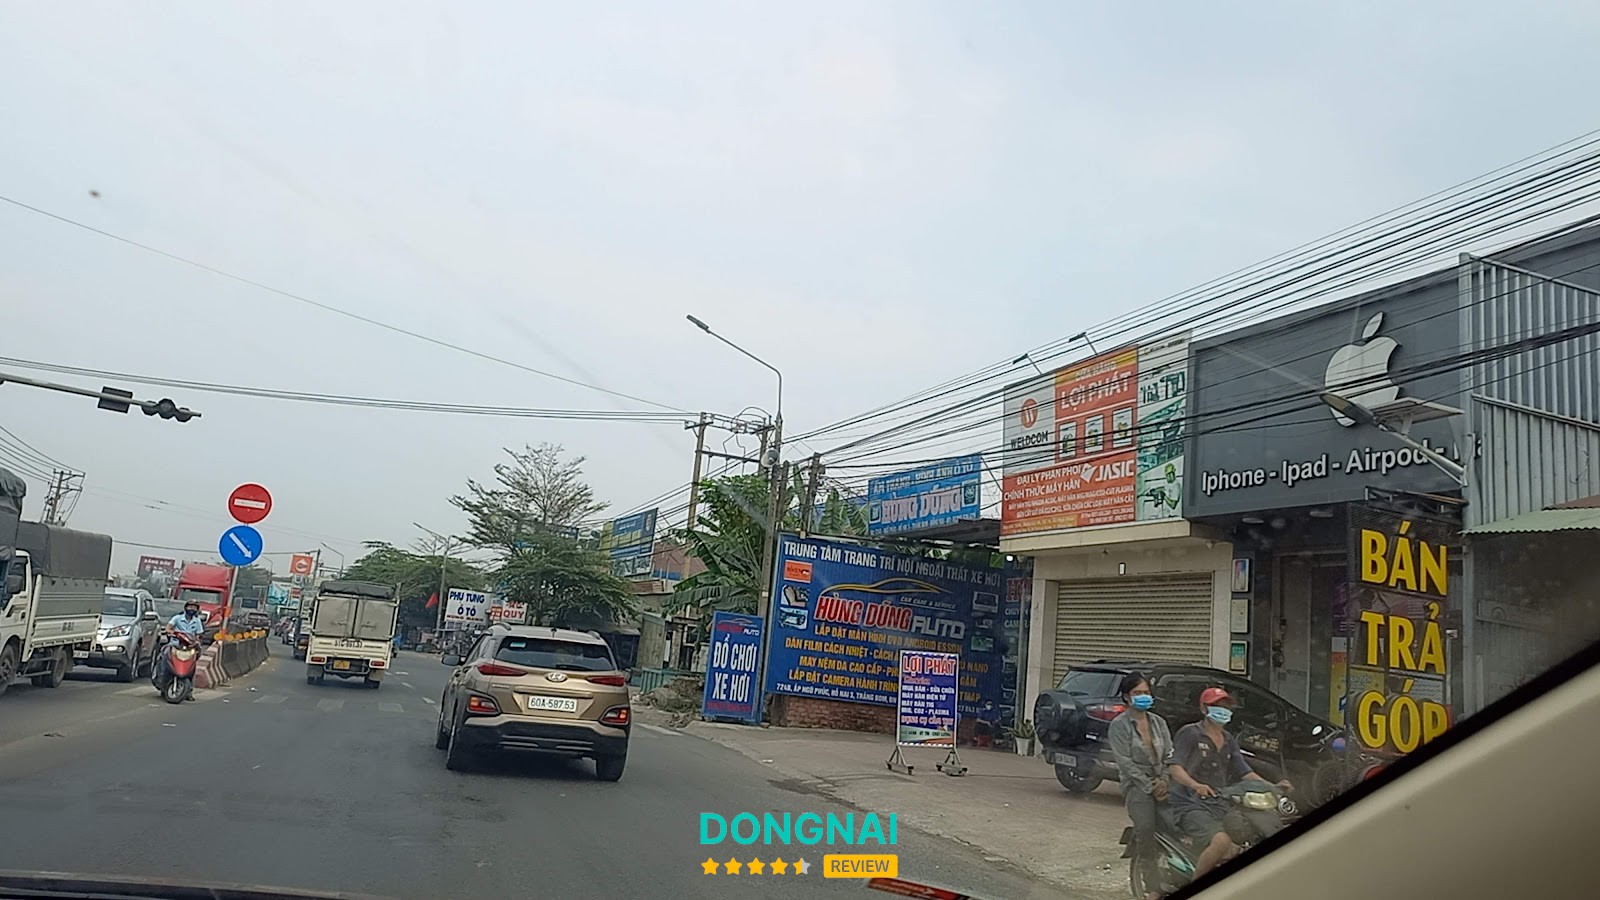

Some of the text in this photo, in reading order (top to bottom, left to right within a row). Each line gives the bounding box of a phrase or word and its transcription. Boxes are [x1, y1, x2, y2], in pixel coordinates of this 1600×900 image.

[1061, 371, 1132, 411] LỢI PHÁT
[1010, 430, 1049, 449] WELDCOM
[1095, 459, 1135, 482] JASIC
[1201, 469, 1265, 497] Iphone
[1281, 453, 1327, 487] Ipad
[1046, 480, 1063, 494] MÁY
[881, 491, 918, 525] HÙNG
[919, 483, 963, 518] DŨNG
[784, 541, 1001, 587] TRUNG TÂM TRANG TRÍ NỘI NGOẠI THẤT XE HƠI
[1360, 520, 1448, 596] BÁN
[449, 591, 464, 604] PHỤ
[503, 609, 525, 619] QUY
[813, 592, 966, 639] HÙNG DŨNG AUTO
[803, 639, 823, 650] FILM
[823, 641, 845, 655] CÁCH
[845, 644, 869, 659] NHIỆT
[873, 647, 893, 661] CÁCH
[887, 634, 902, 646] DVD
[904, 637, 937, 650] ANDROID
[1360, 601, 1447, 675] TRẢ
[730, 642, 758, 673] CHƠI
[799, 655, 817, 667] MAY
[836, 660, 848, 671] DA
[848, 662, 865, 674] CAO
[866, 660, 883, 676] CẤP
[902, 654, 923, 677] LỢI
[924, 653, 956, 676] PHÁT
[712, 672, 750, 703] XE HƠI
[788, 666, 805, 680] LẮP
[806, 671, 822, 685] ĐẶT
[822, 673, 855, 687] CAMERA
[855, 677, 878, 691] HÀNH
[530, 697, 575, 710] 60A-587.53
[928, 708, 950, 716] PLASMA
[1357, 679, 1449, 754] GÓP
